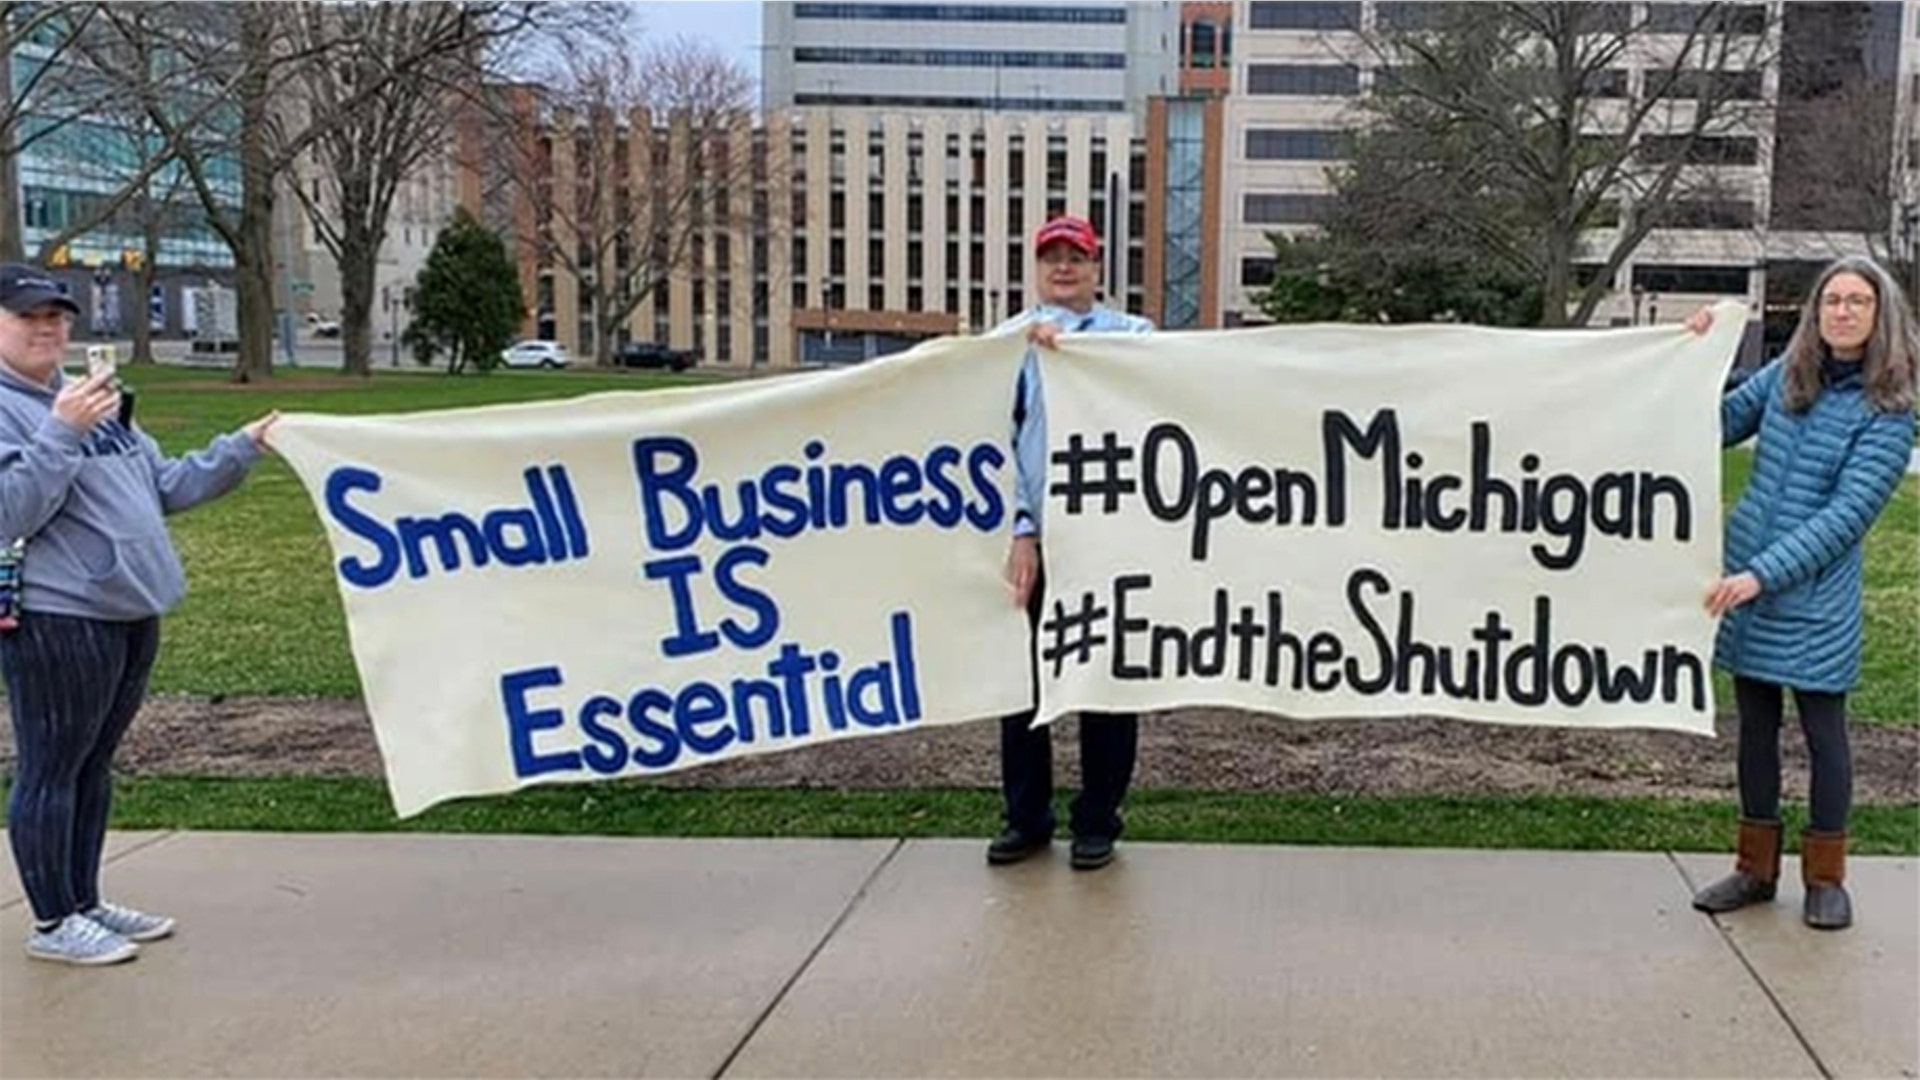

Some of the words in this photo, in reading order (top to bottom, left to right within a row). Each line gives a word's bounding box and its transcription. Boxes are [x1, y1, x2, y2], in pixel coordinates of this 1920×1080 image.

[325, 465, 589, 588] Small
[633, 436, 1005, 552] Business
[1049, 408, 1692, 571] #OpenMichigan
[644, 545, 779, 658] IS
[1042, 568, 1706, 712] #EndtheShutdown
[501, 612, 921, 779] Essential
